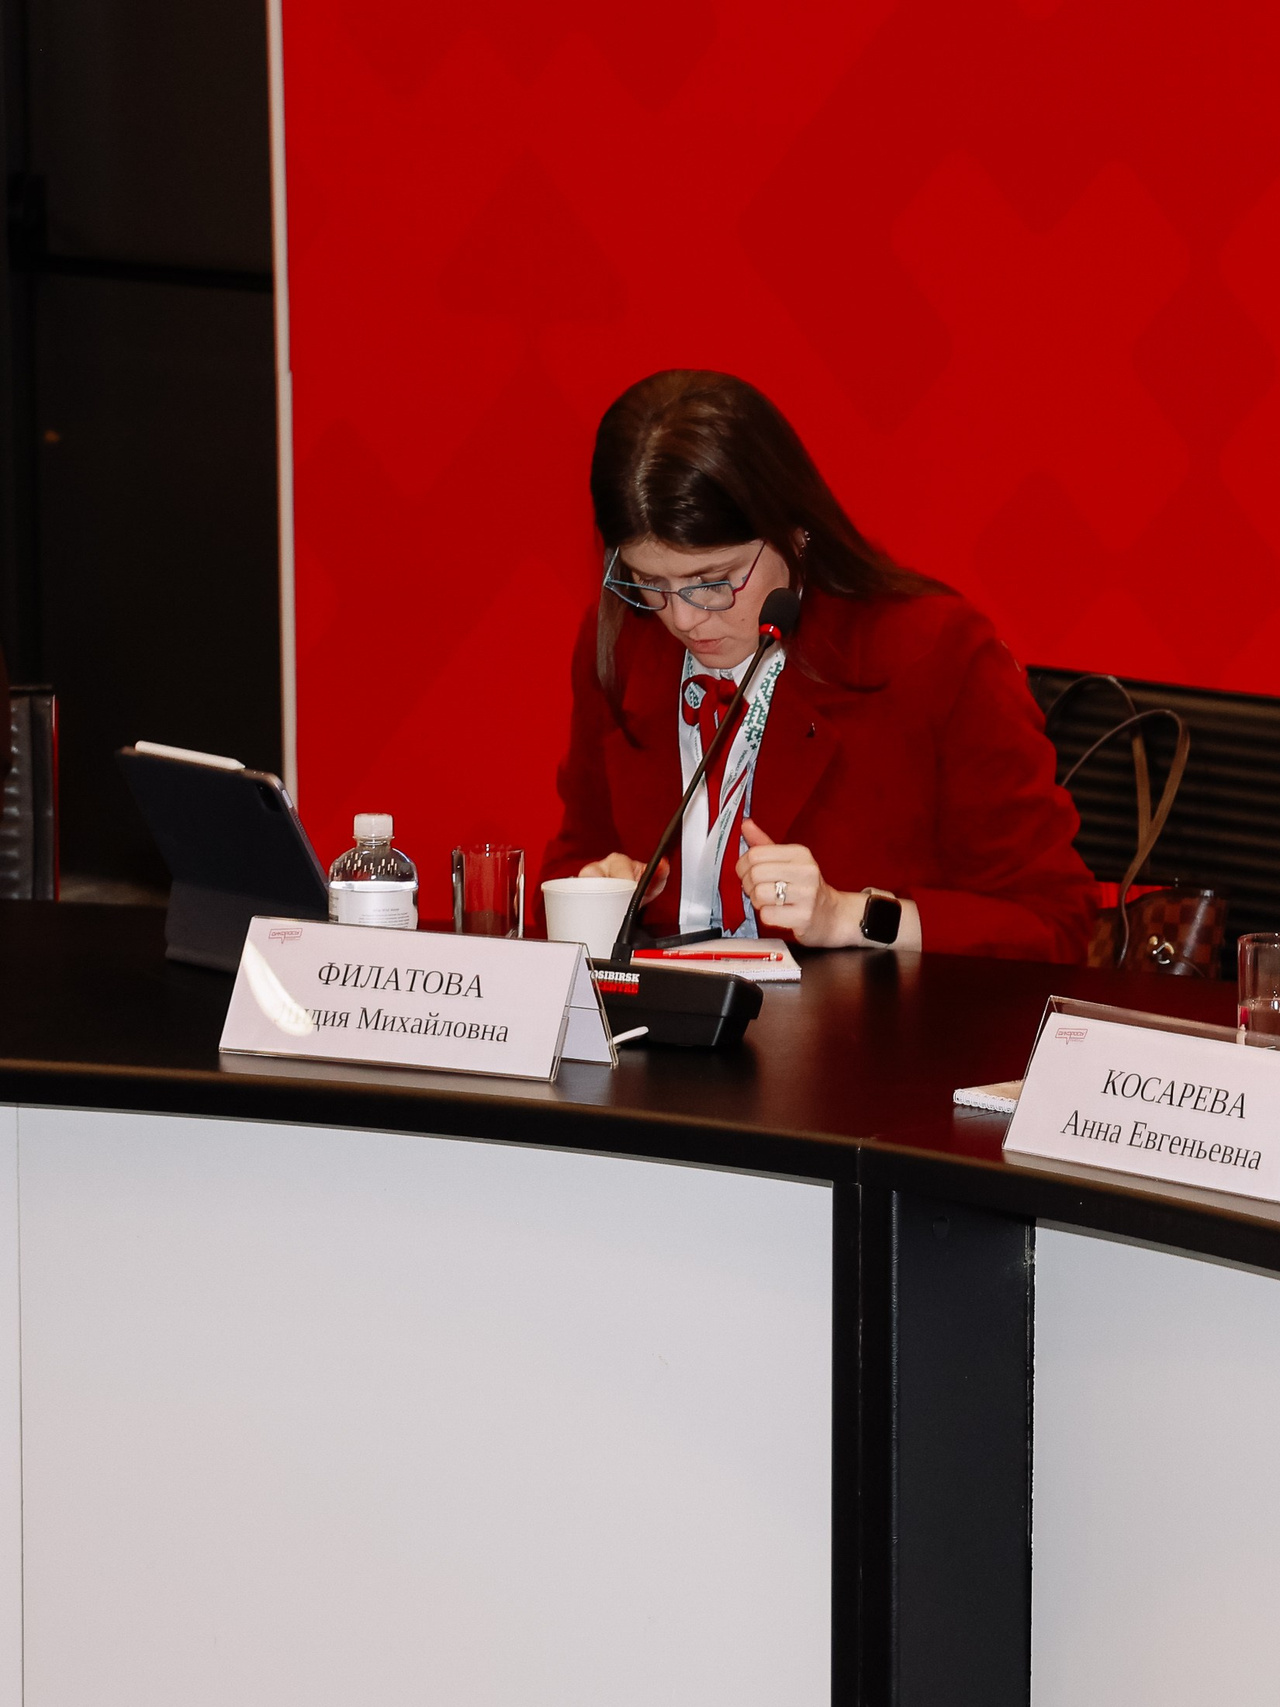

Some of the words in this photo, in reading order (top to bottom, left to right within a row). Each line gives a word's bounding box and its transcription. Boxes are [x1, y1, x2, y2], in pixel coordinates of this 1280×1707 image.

[317, 962, 484, 998] ФИЛАТОВА
[590, 970, 640, 983] OSIBIRSK
[276, 1001, 351, 1031] дия
[356, 1007, 509, 1042] Михайловна
[1101, 1068, 1246, 1119] КОСАРЕВА
[1060, 1109, 1122, 1143] Анна
[1127, 1120, 1263, 1170] Евгеньевна
